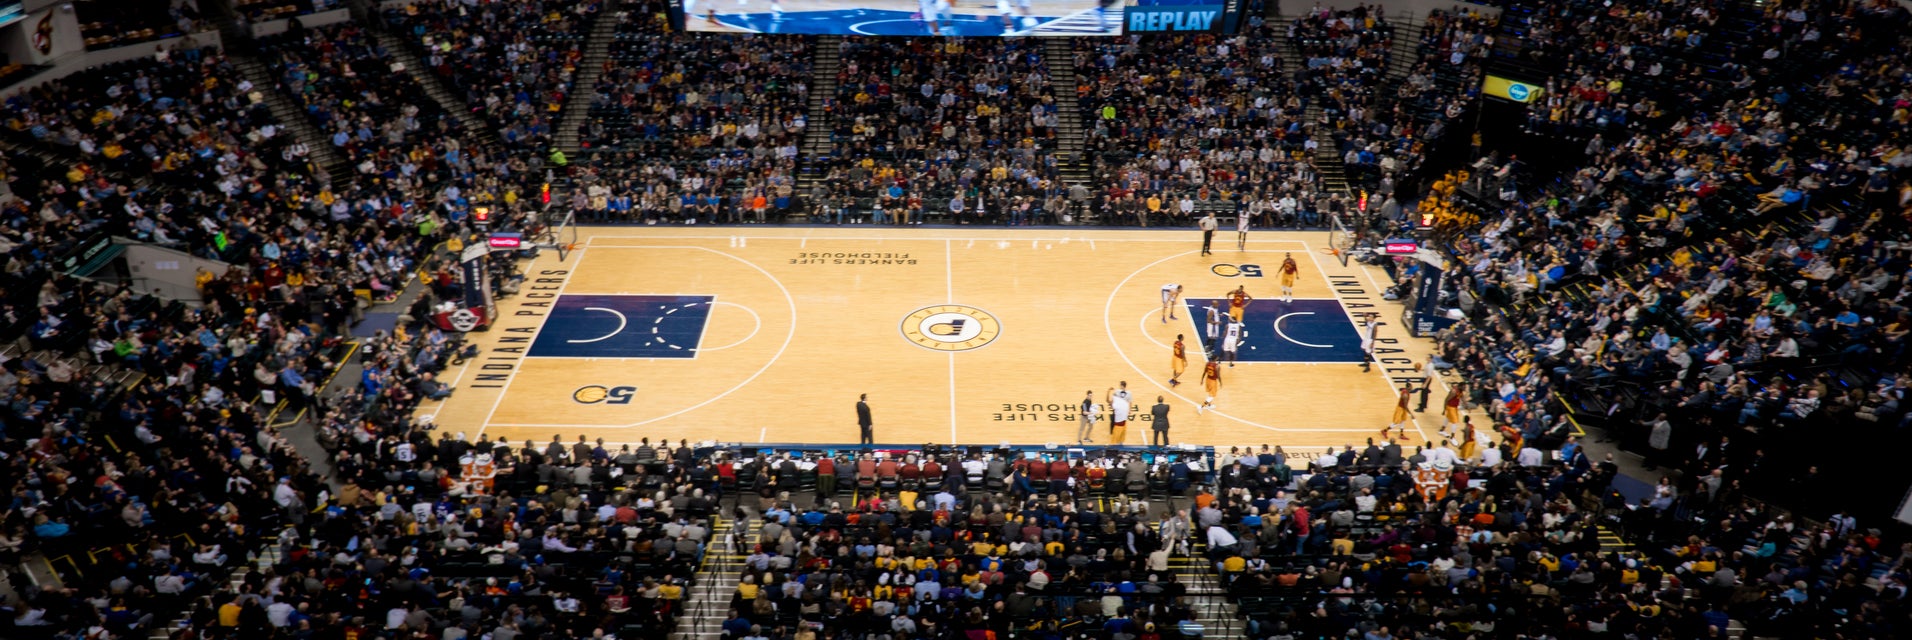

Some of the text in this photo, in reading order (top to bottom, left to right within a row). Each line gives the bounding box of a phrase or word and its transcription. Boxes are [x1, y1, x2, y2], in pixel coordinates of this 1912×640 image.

[1129, 11, 1216, 31] REPLAY
[470, 269, 568, 388] INDIANA PACERS
[993, 413, 1037, 421] LIFE
